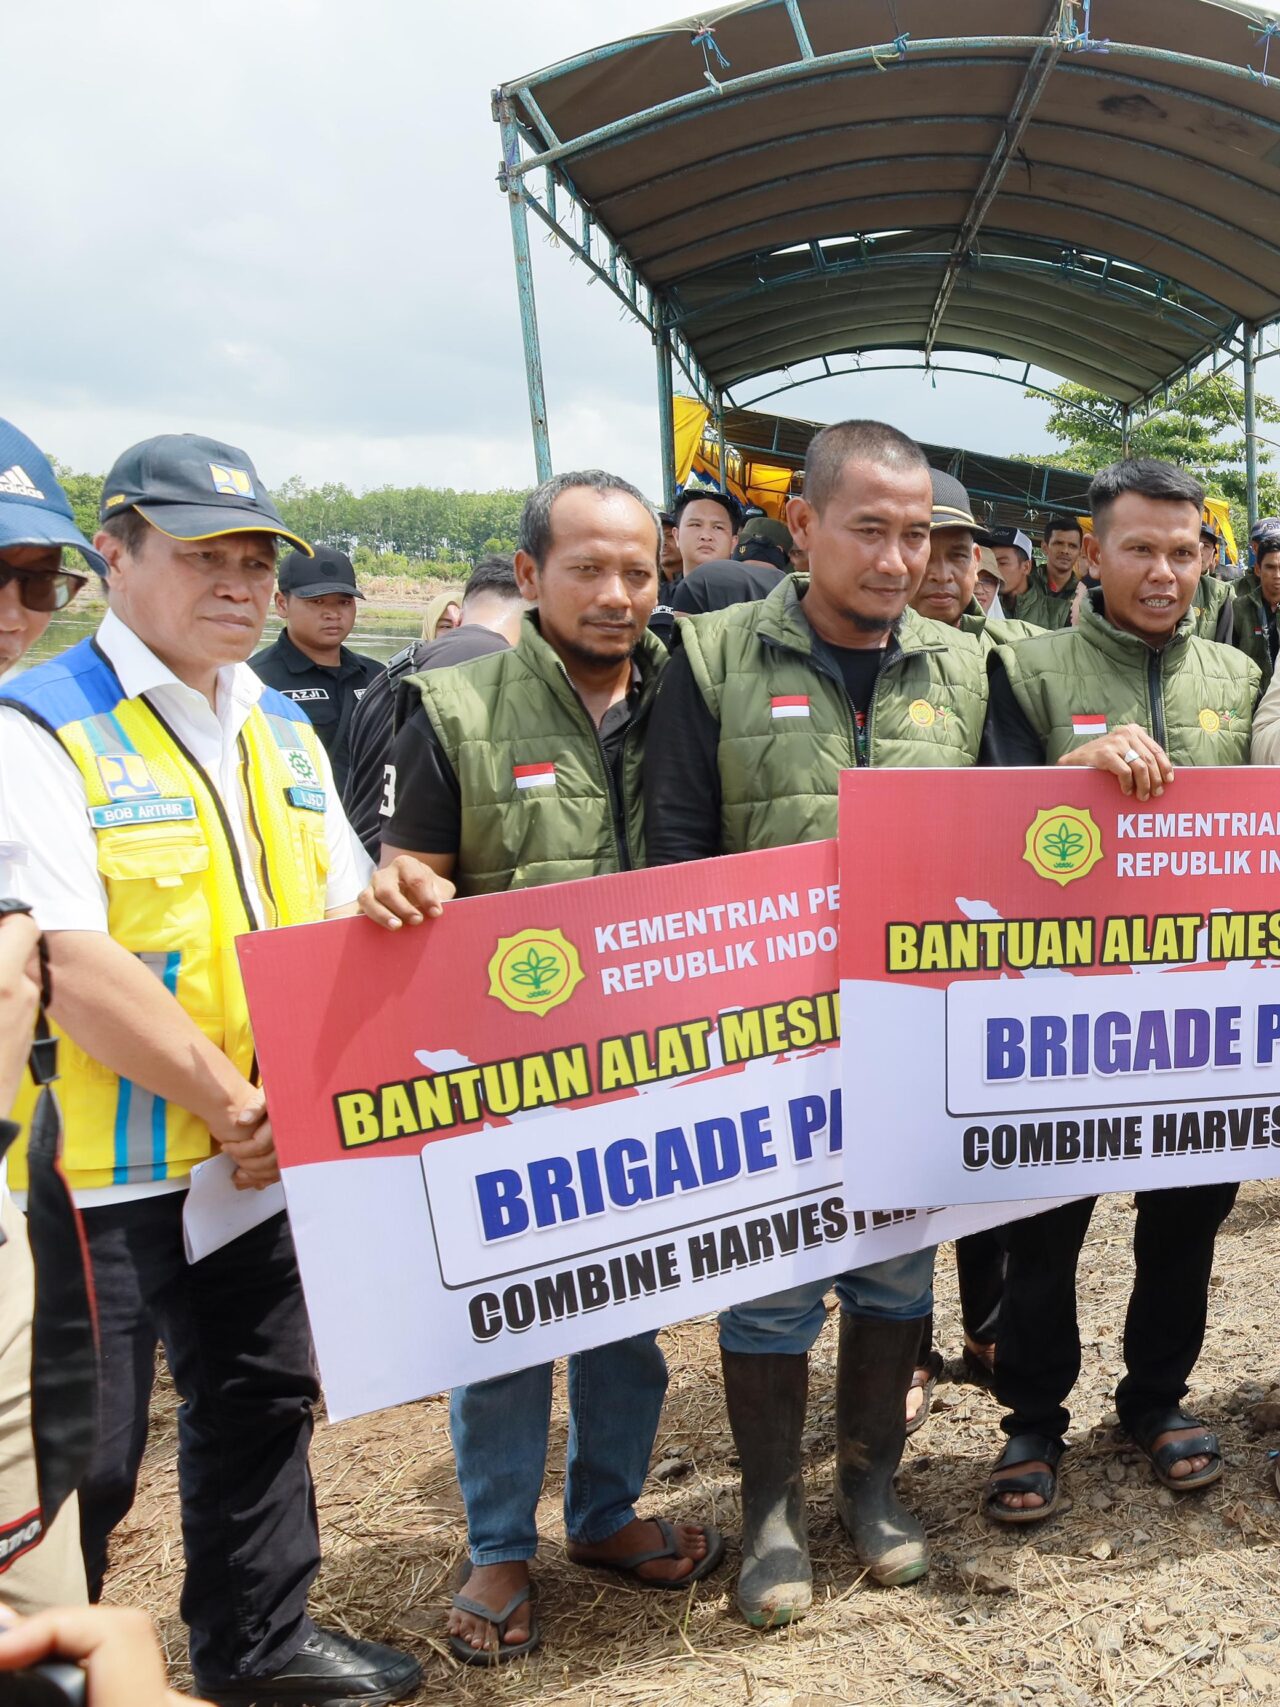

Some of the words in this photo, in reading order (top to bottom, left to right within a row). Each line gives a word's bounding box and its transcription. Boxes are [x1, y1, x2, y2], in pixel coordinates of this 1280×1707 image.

[104, 807, 134, 822] BOB
[138, 803, 184, 819] ARTHUR
[1116, 850, 1252, 878] REPUBLIK
[594, 891, 800, 954] KEMENTRIAN
[887, 918, 1094, 972] BANTUAN
[1101, 915, 1202, 965] ALAT
[600, 940, 759, 996] REPUBLIK
[335, 1045, 591, 1149] BANTUAN
[600, 1017, 711, 1092] ALAT
[718, 991, 841, 1065] MESI
[985, 1005, 1242, 1081] BRIGADE
[962, 1115, 1143, 1171] COMBINE
[474, 1105, 778, 1242] BRIGADE
[467, 1242, 681, 1342] COMBINE
[688, 1196, 916, 1283] HARVES
